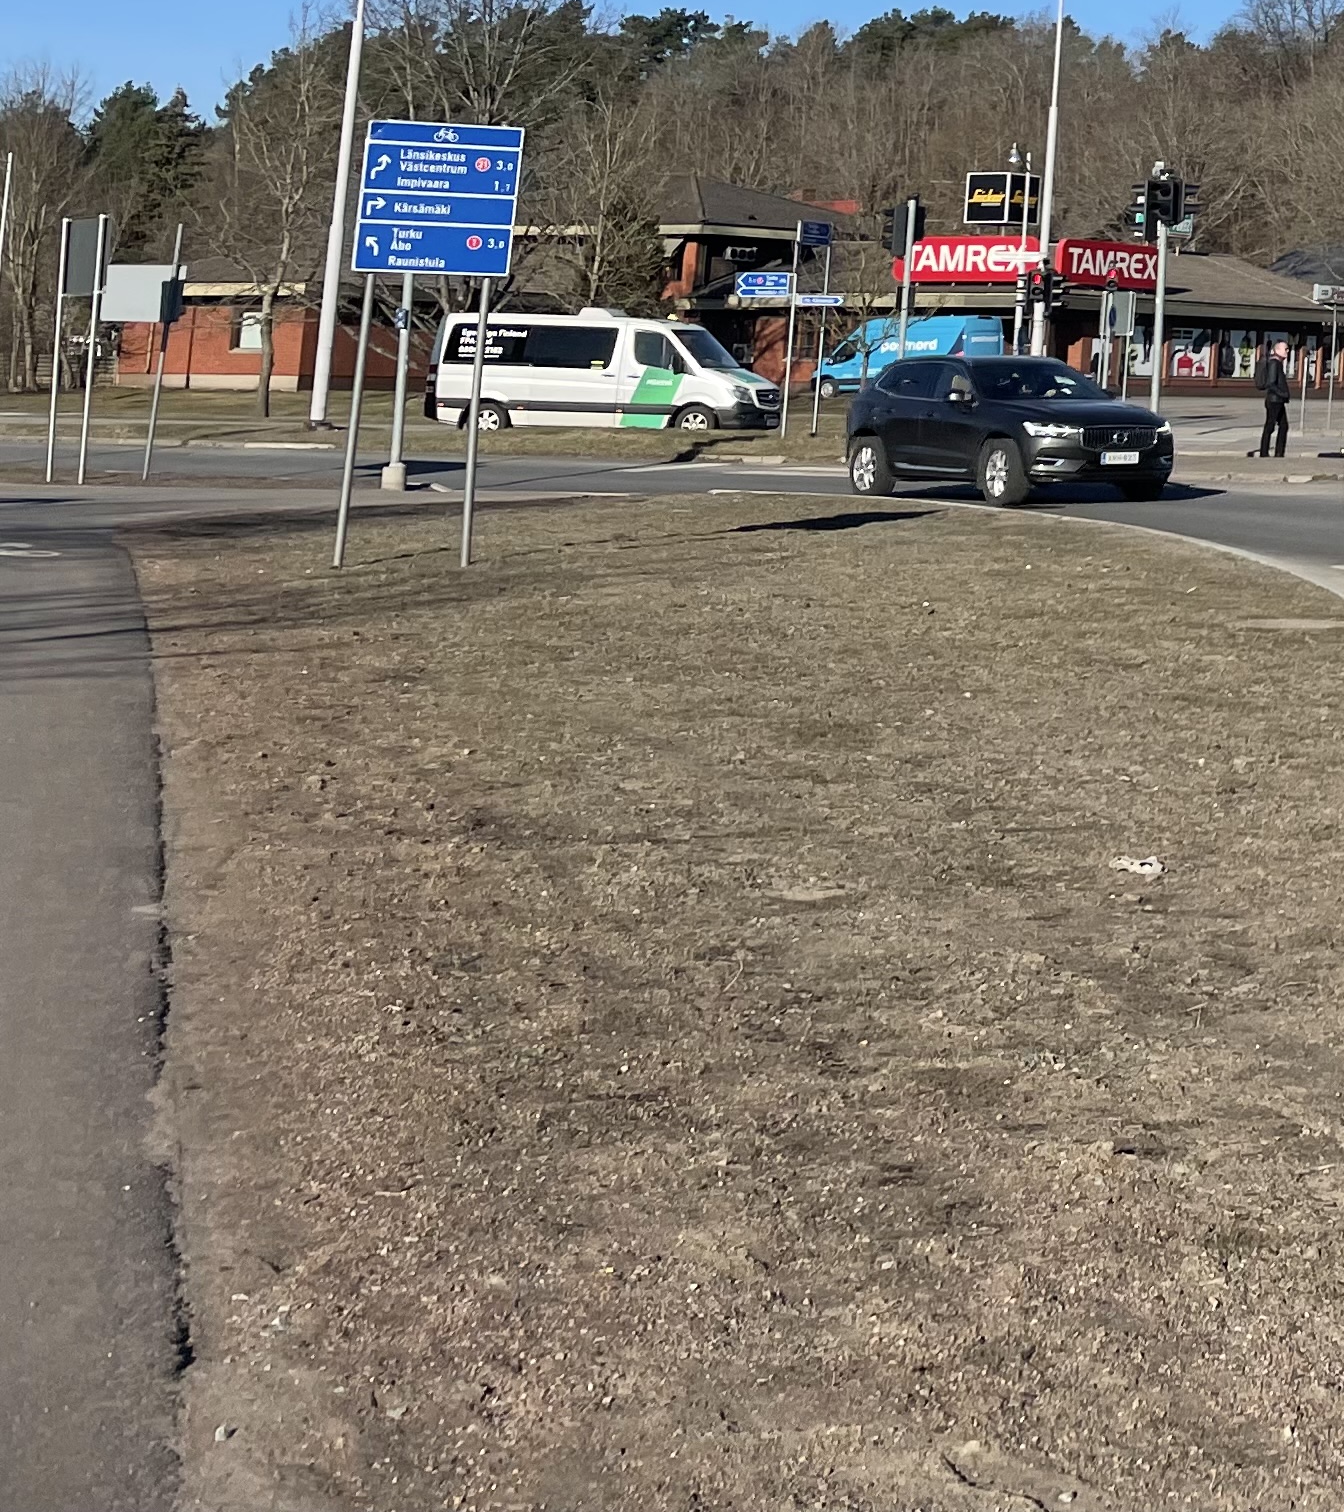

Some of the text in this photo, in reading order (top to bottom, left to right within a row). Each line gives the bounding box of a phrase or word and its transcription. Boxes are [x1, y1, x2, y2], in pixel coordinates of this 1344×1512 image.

[400, 148, 466, 163] Länsikeskus
[399, 160, 468, 175] Västcentrum
[397, 177, 450, 189] Impivaara
[911, 244, 1027, 273] TAMREX
[1068, 247, 1158, 280] TAMREX
